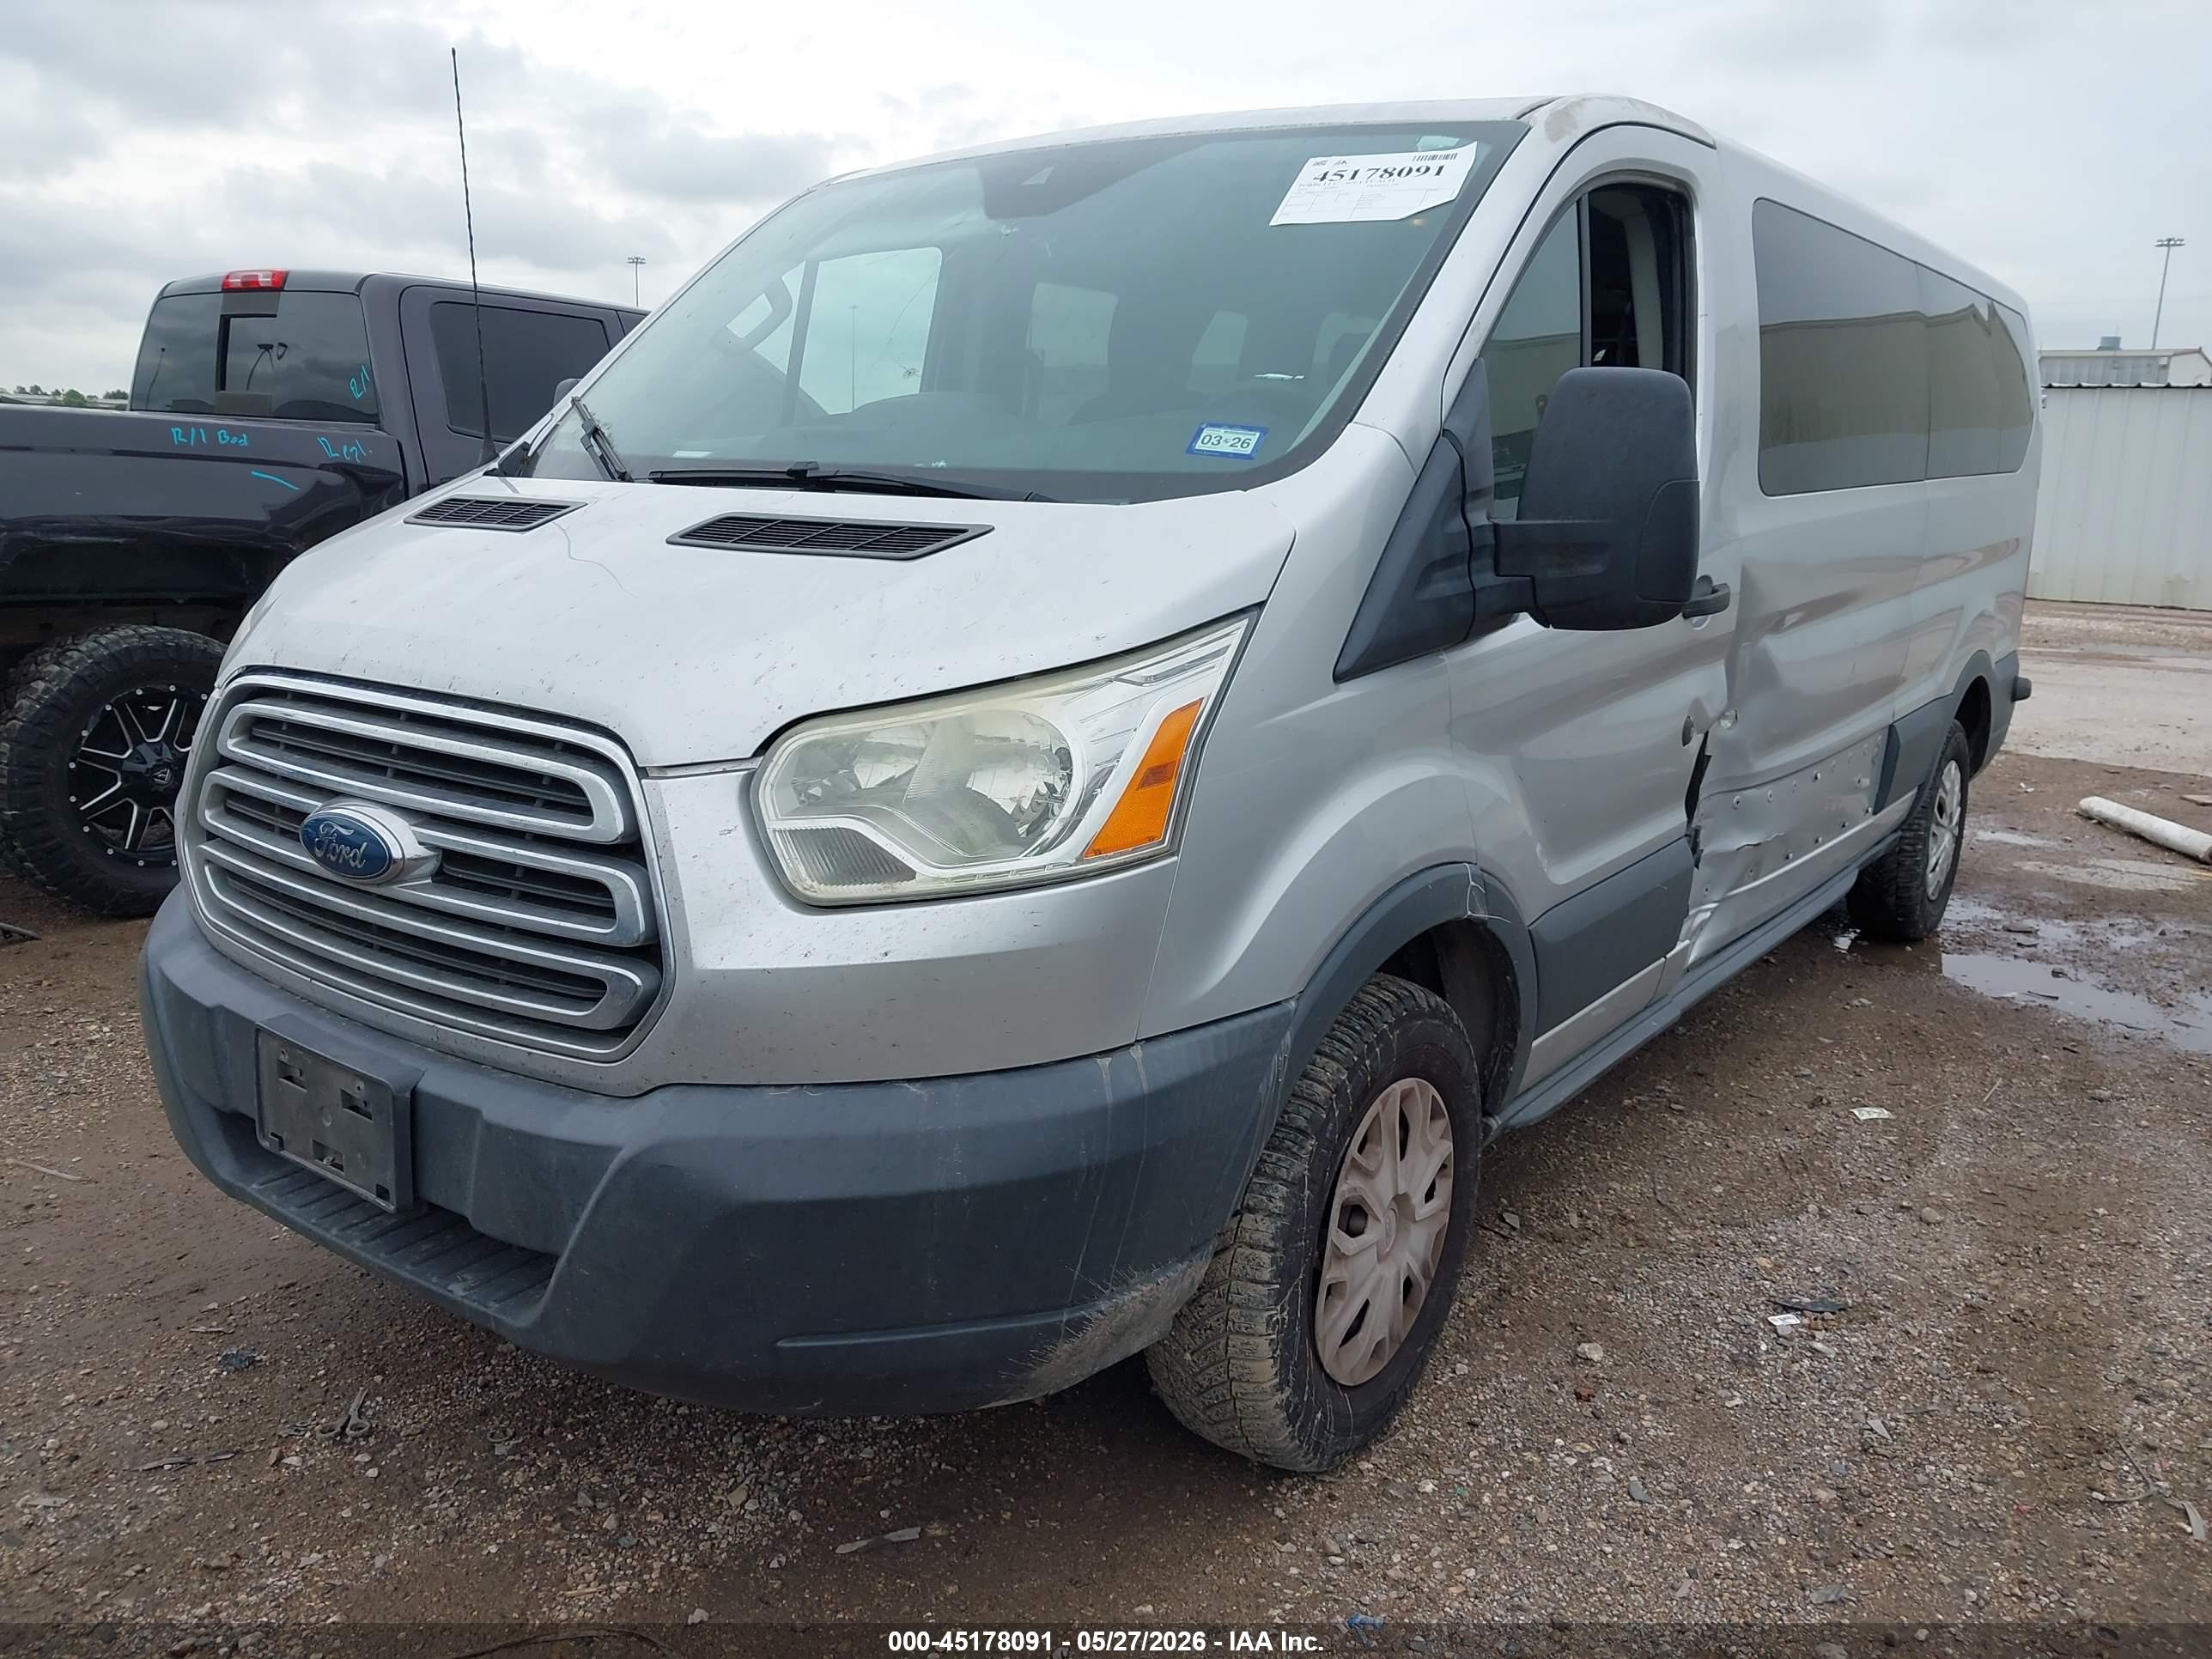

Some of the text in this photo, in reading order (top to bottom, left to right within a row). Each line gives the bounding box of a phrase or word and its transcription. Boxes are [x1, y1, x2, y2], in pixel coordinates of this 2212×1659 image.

[1312, 164, 1445, 182] 45178091
[1229, 436, 1253, 449] 26
[313, 820, 368, 870] Ford
